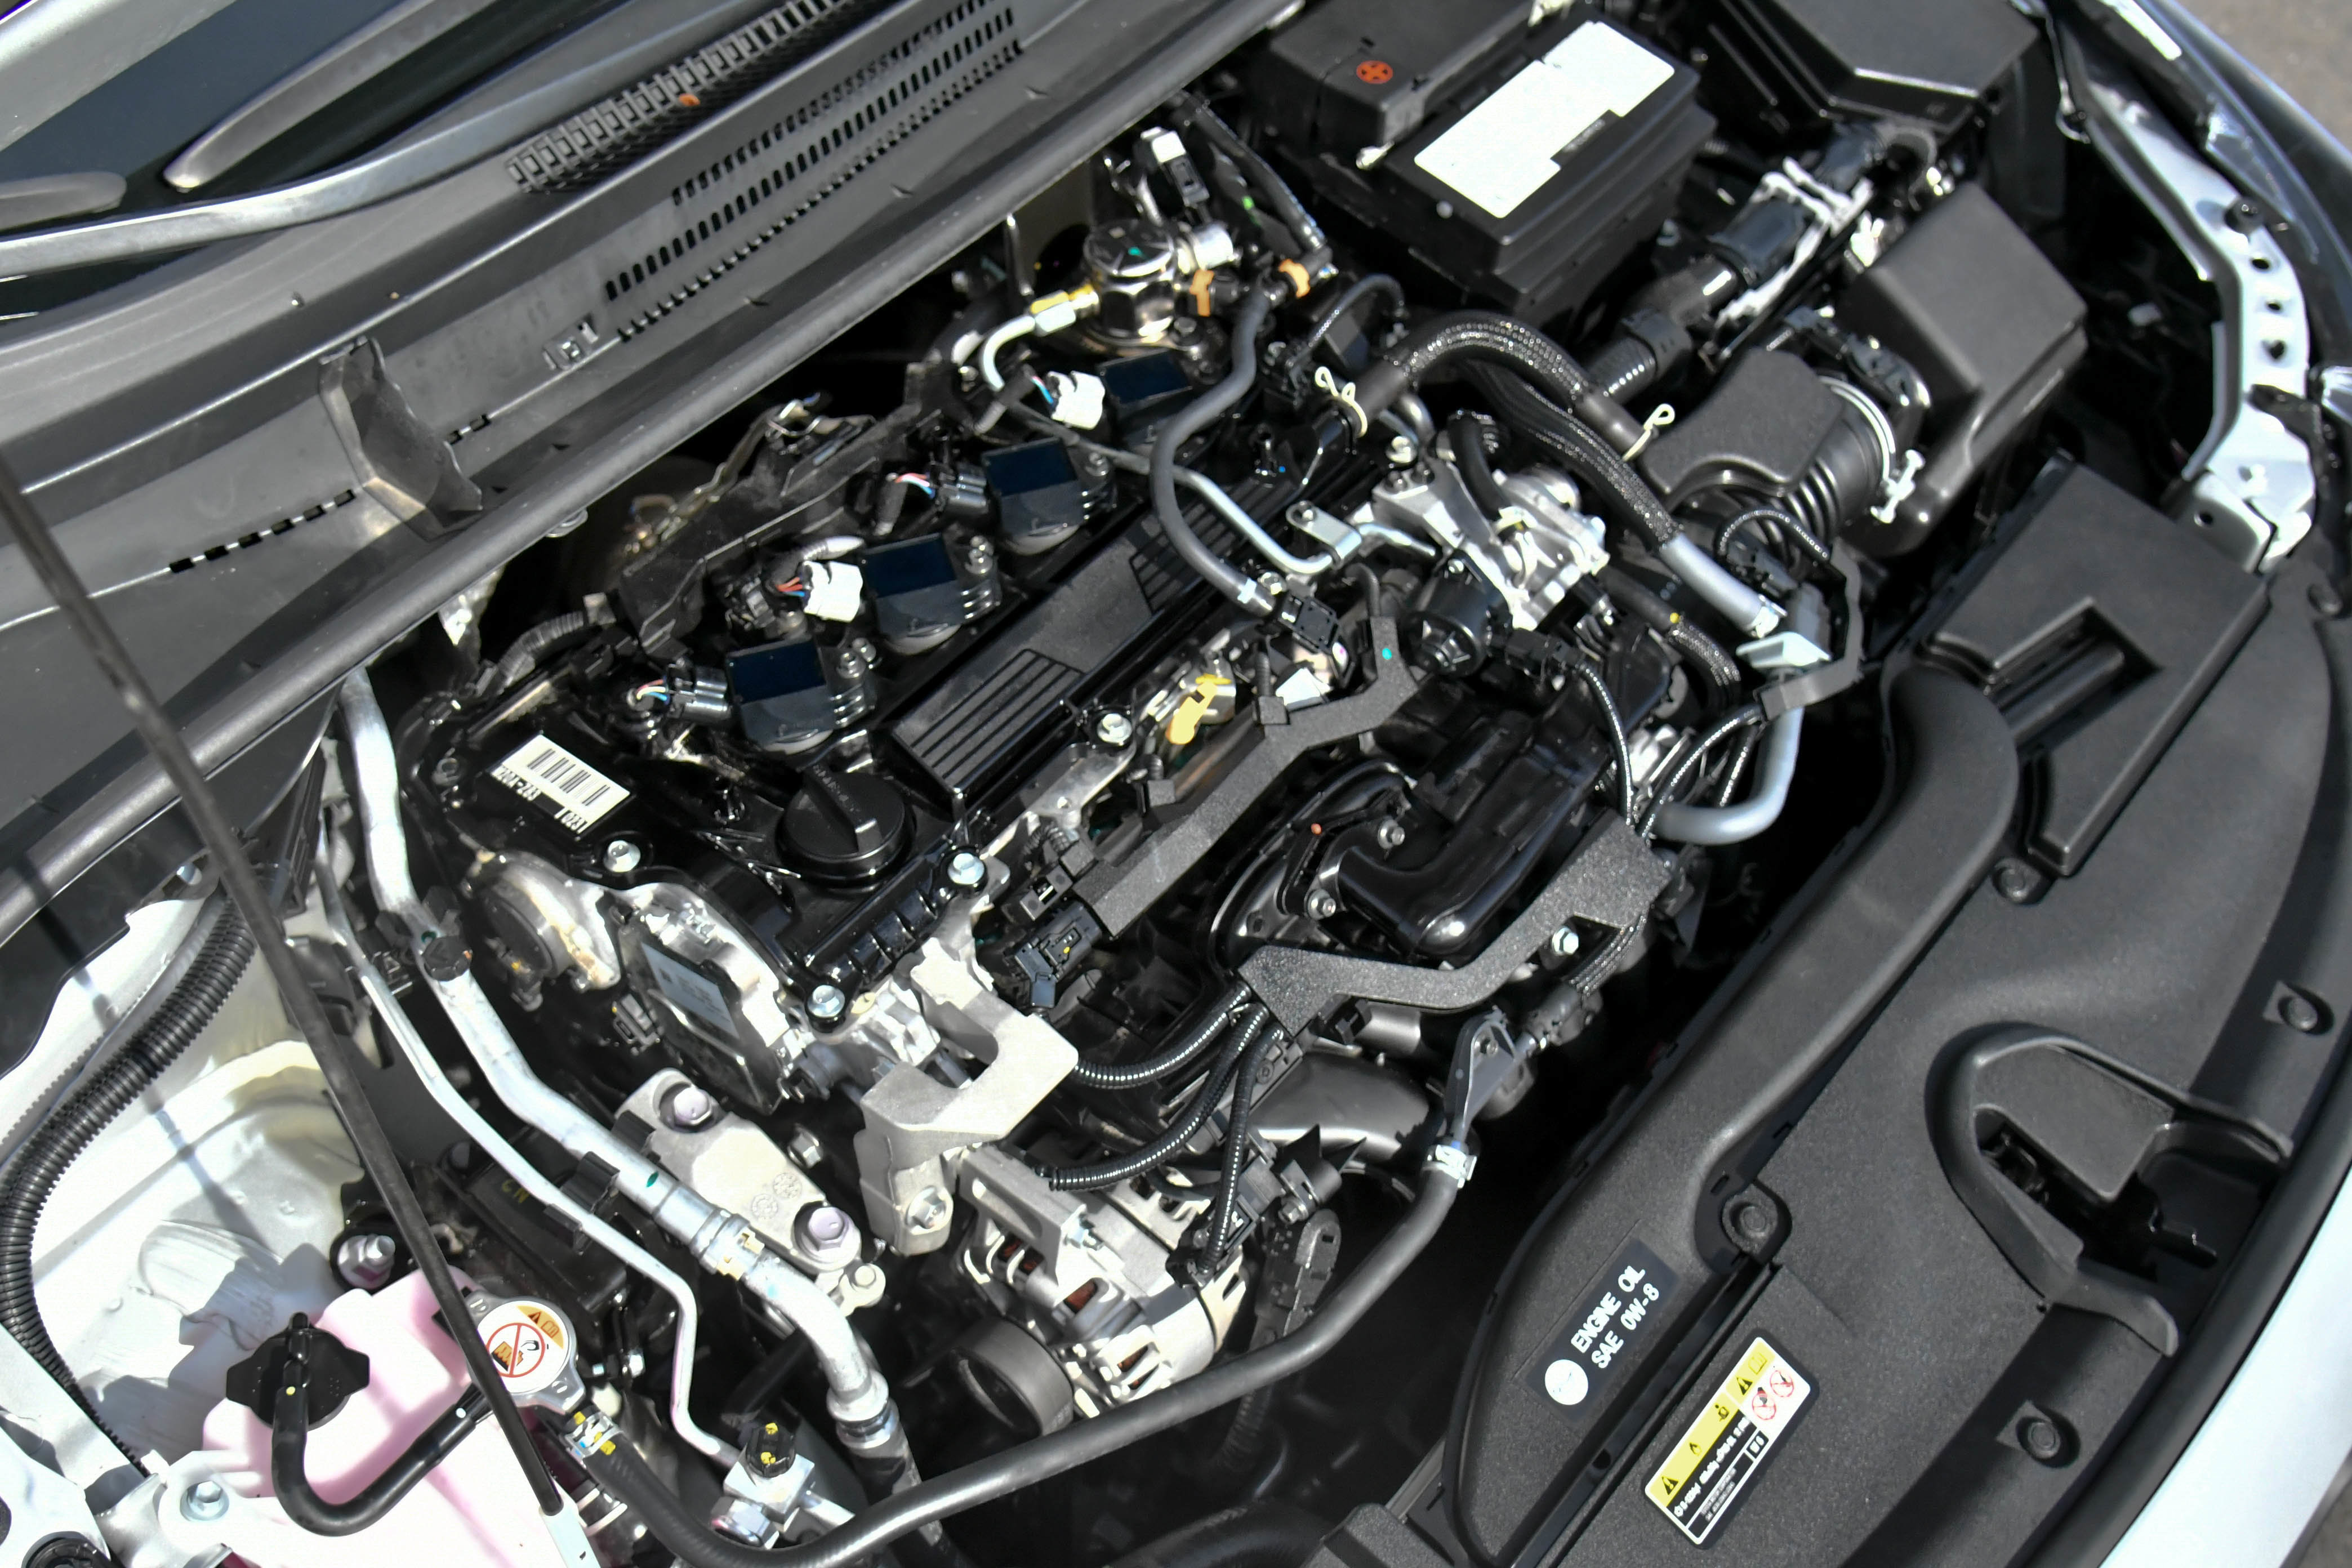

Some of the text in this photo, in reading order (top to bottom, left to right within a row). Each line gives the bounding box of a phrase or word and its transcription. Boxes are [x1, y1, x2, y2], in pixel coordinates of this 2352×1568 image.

[1571, 1266, 1646, 1353] ENGINE OIL
[1592, 1283, 1659, 1369] SAE 0W-8
